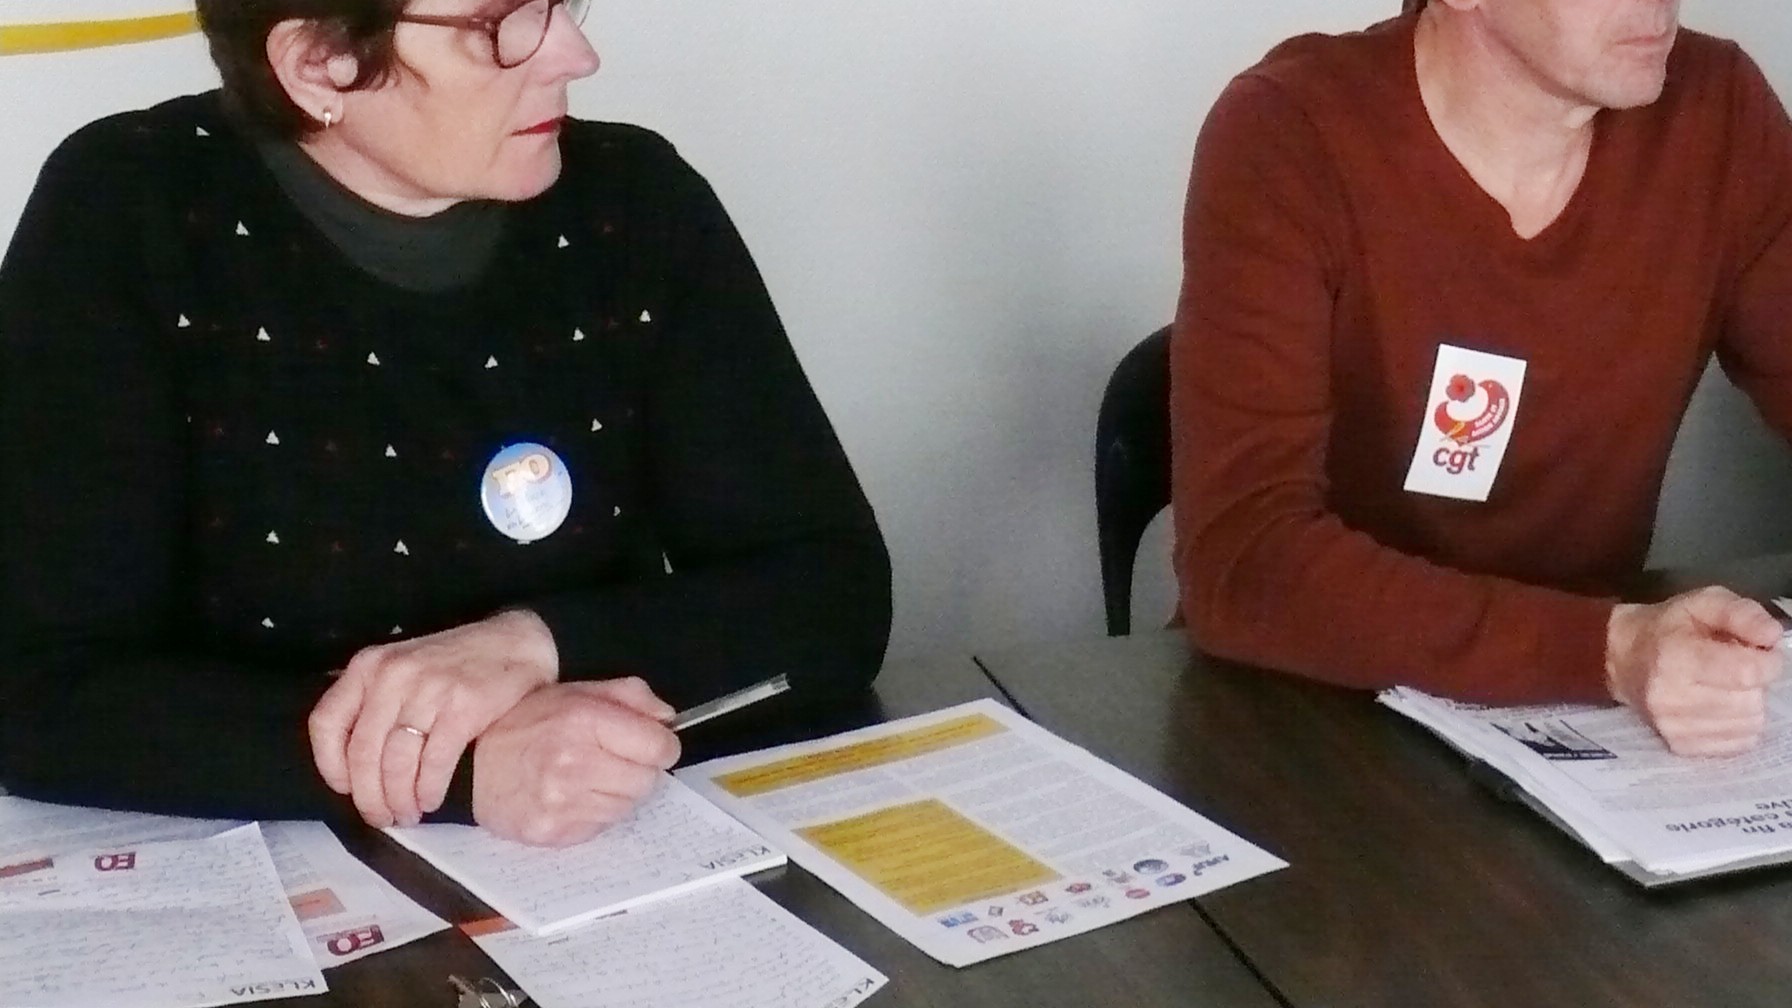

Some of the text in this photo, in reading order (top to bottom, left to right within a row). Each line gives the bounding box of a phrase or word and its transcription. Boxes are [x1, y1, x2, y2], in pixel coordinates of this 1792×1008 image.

[1433, 447, 1479, 475] cgt
[1666, 812, 1780, 834] catégorie
[1742, 822, 1776, 834] fin
